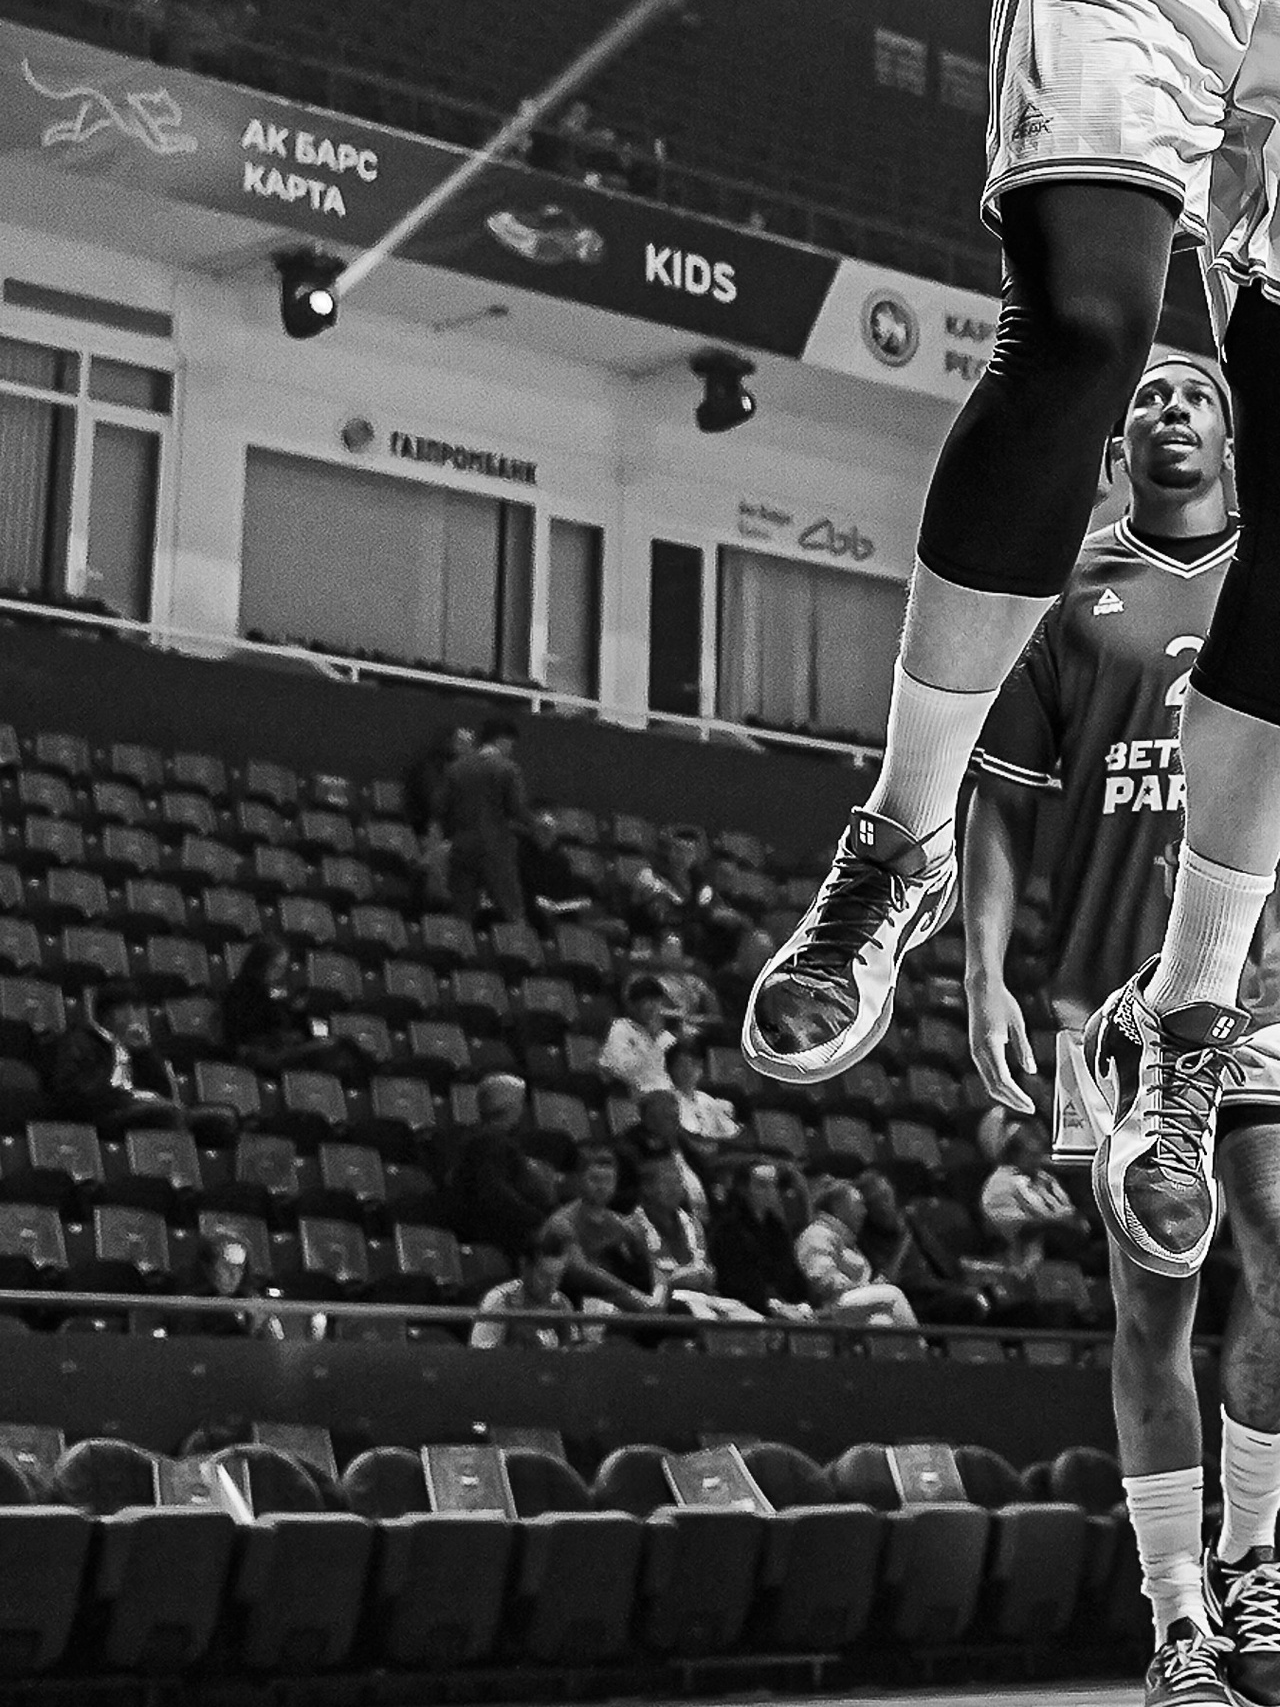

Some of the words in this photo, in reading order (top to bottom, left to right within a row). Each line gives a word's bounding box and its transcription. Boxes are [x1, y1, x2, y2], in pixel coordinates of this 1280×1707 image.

[241, 119, 289, 159] АК
[295, 130, 379, 183] БАРС
[243, 161, 346, 218] КАРТА
[645, 243, 738, 304] KIDS
[1102, 775, 1187, 814] PAR
